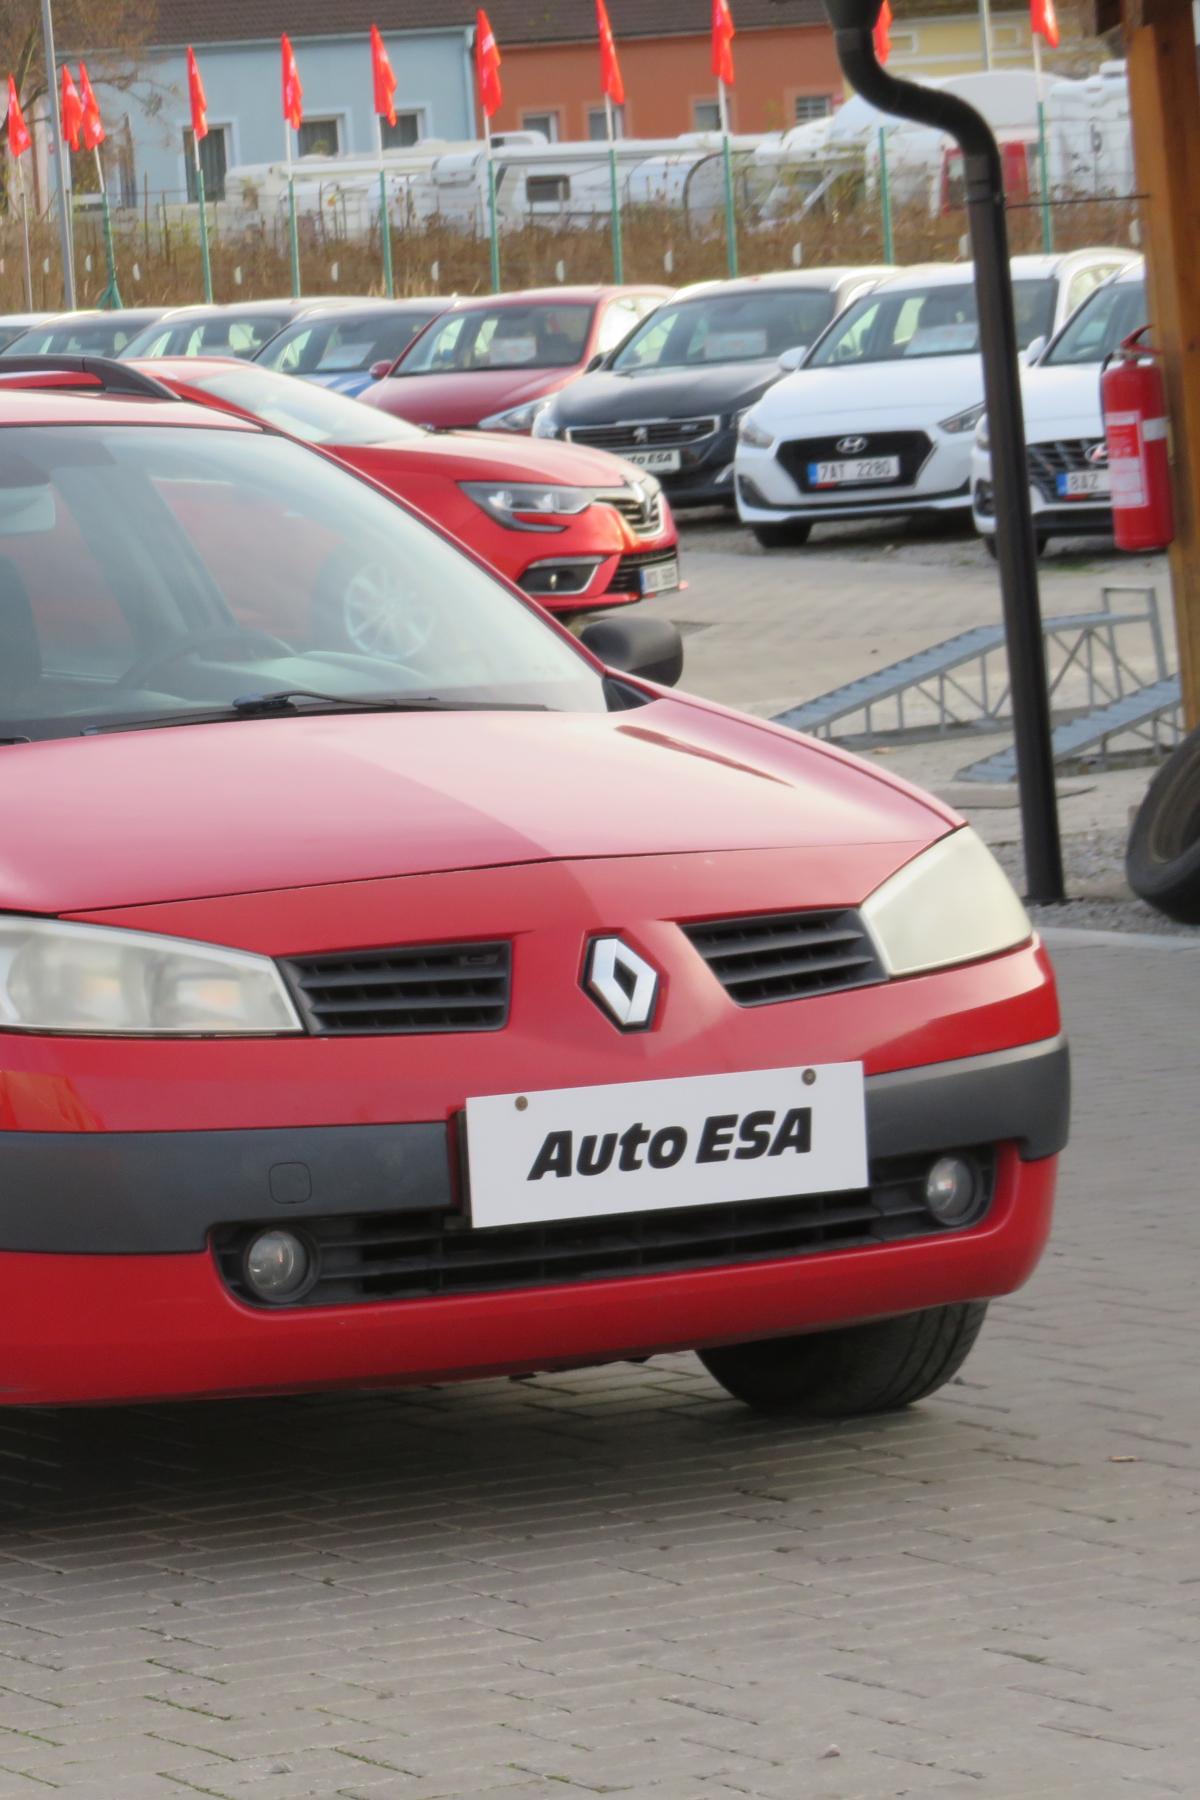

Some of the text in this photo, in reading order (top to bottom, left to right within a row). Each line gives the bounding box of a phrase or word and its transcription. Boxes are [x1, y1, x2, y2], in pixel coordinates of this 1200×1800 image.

[647, 452, 673, 463] ESA
[526, 1106, 813, 1181] Auto ESA
